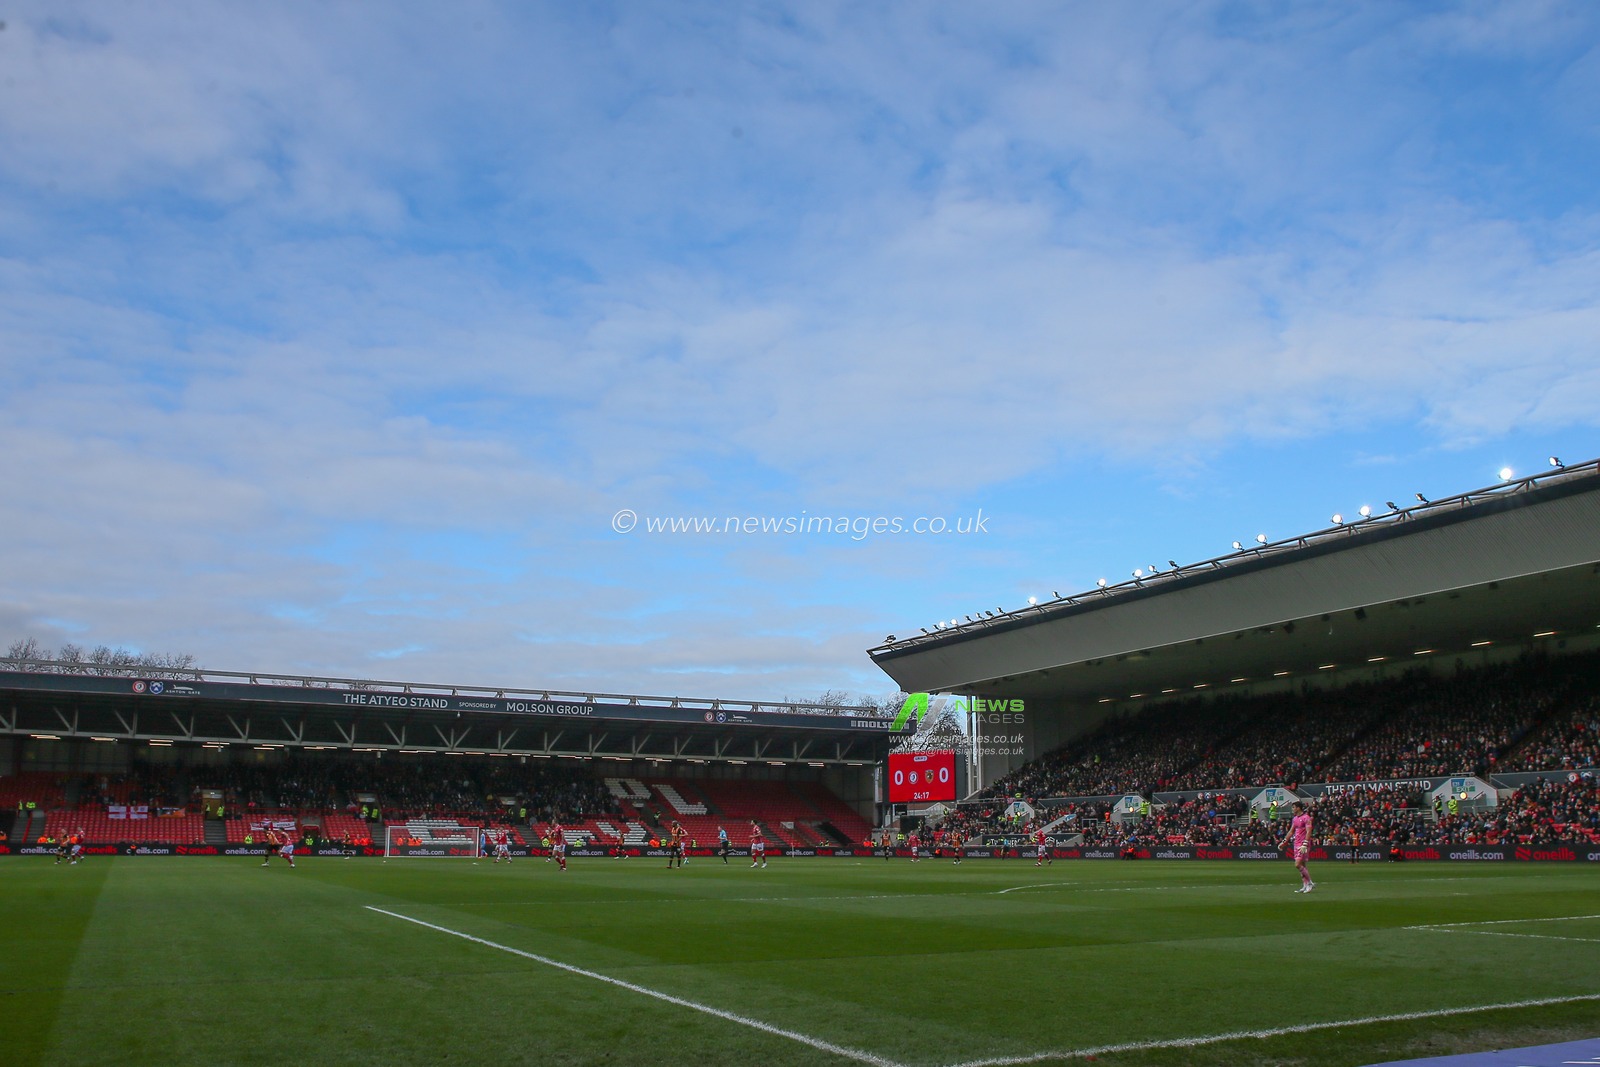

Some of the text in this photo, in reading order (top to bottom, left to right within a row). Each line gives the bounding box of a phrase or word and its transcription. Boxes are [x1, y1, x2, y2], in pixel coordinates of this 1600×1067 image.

[343, 693, 448, 708] THE ATYEO STAND
[506, 702, 593, 715] MOLSON GROUP
[894, 770, 904, 785] 0
[938, 767, 949, 783] 0
[913, 791, 930, 799] 24:17
[20, 846, 67, 854] oneills.co
[126, 846, 169, 854] oeills.com
[1156, 850, 1190, 859] oneills.com
[1239, 850, 1278, 859] oneills.com
[1405, 847, 1440, 859] oneills
[1449, 849, 1504, 860] oneills.com
[1533, 847, 1576, 860] oneills
